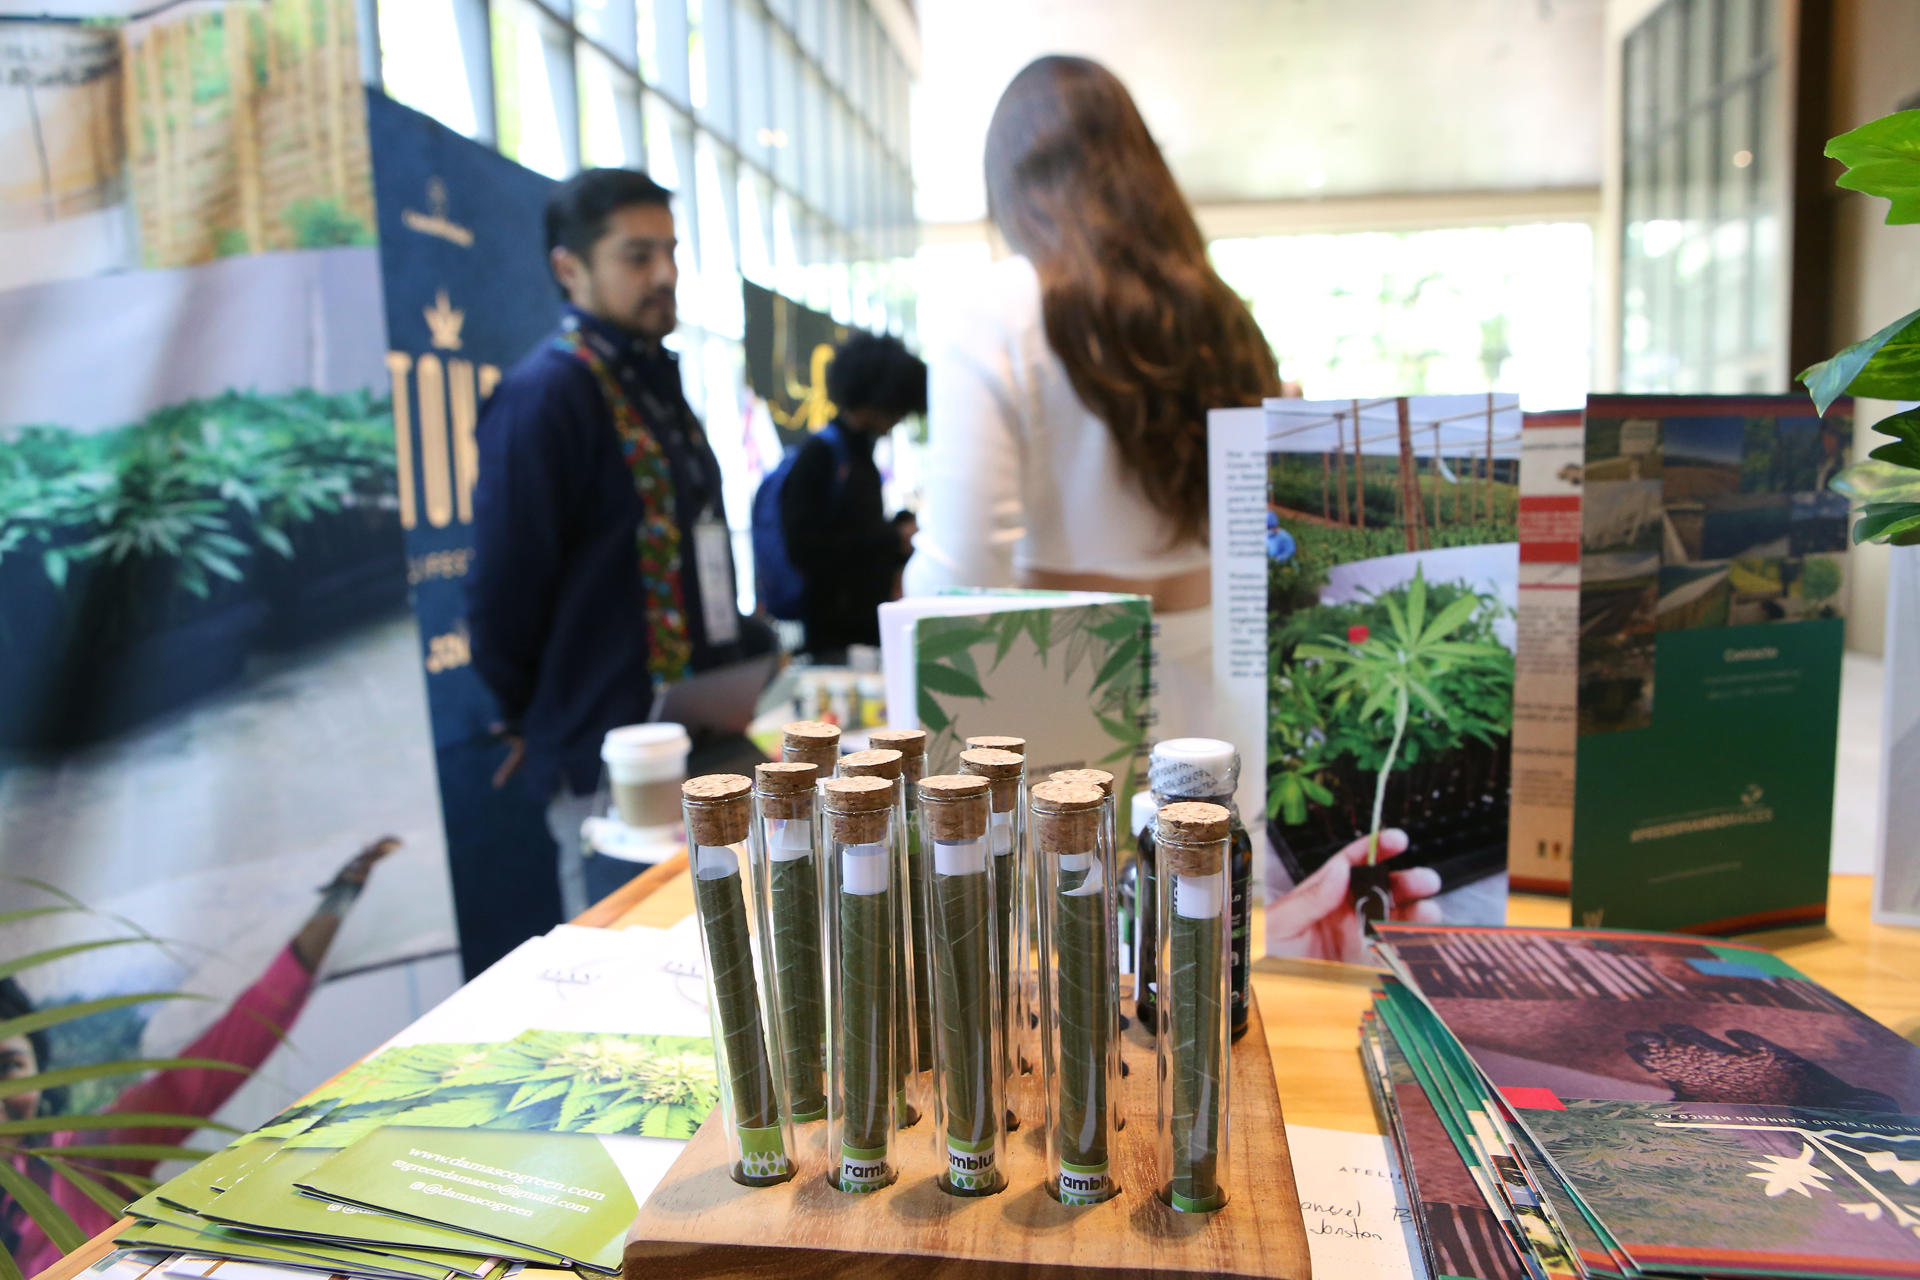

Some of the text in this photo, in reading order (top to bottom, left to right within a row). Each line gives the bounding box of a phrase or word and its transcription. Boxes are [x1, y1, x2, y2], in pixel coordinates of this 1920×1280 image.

[1735, 1115, 1807, 1124] CANNABIS
[401, 1159, 590, 1214] greendamasco@gmail.com
[408, 1148, 606, 1201] www.damascogreen.com
[423, 1183, 534, 1218] @damascogreen
